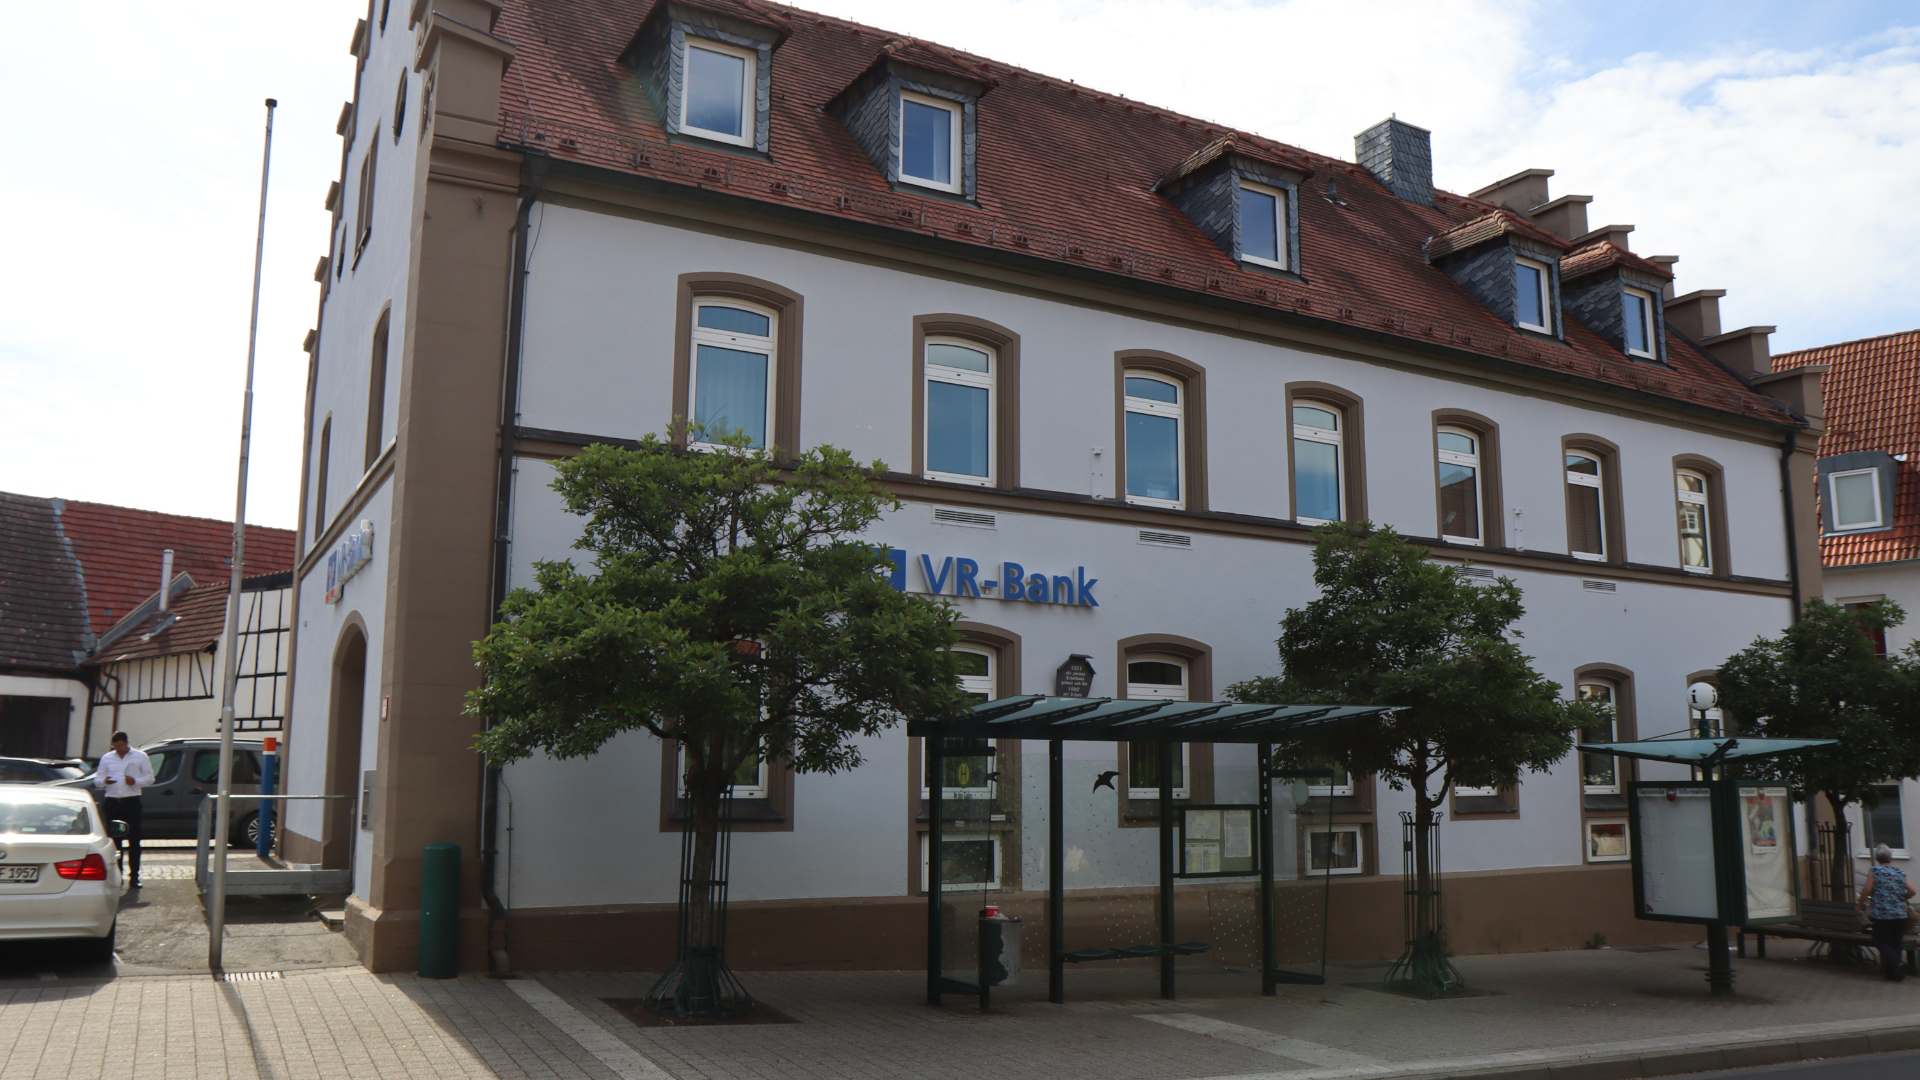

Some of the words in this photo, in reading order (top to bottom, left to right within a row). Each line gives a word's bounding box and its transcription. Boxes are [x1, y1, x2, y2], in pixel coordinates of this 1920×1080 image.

[919, 554, 1099, 607] VR-Bank
[960, 765, 967, 782] H
[8, 867, 37, 878] 1957
